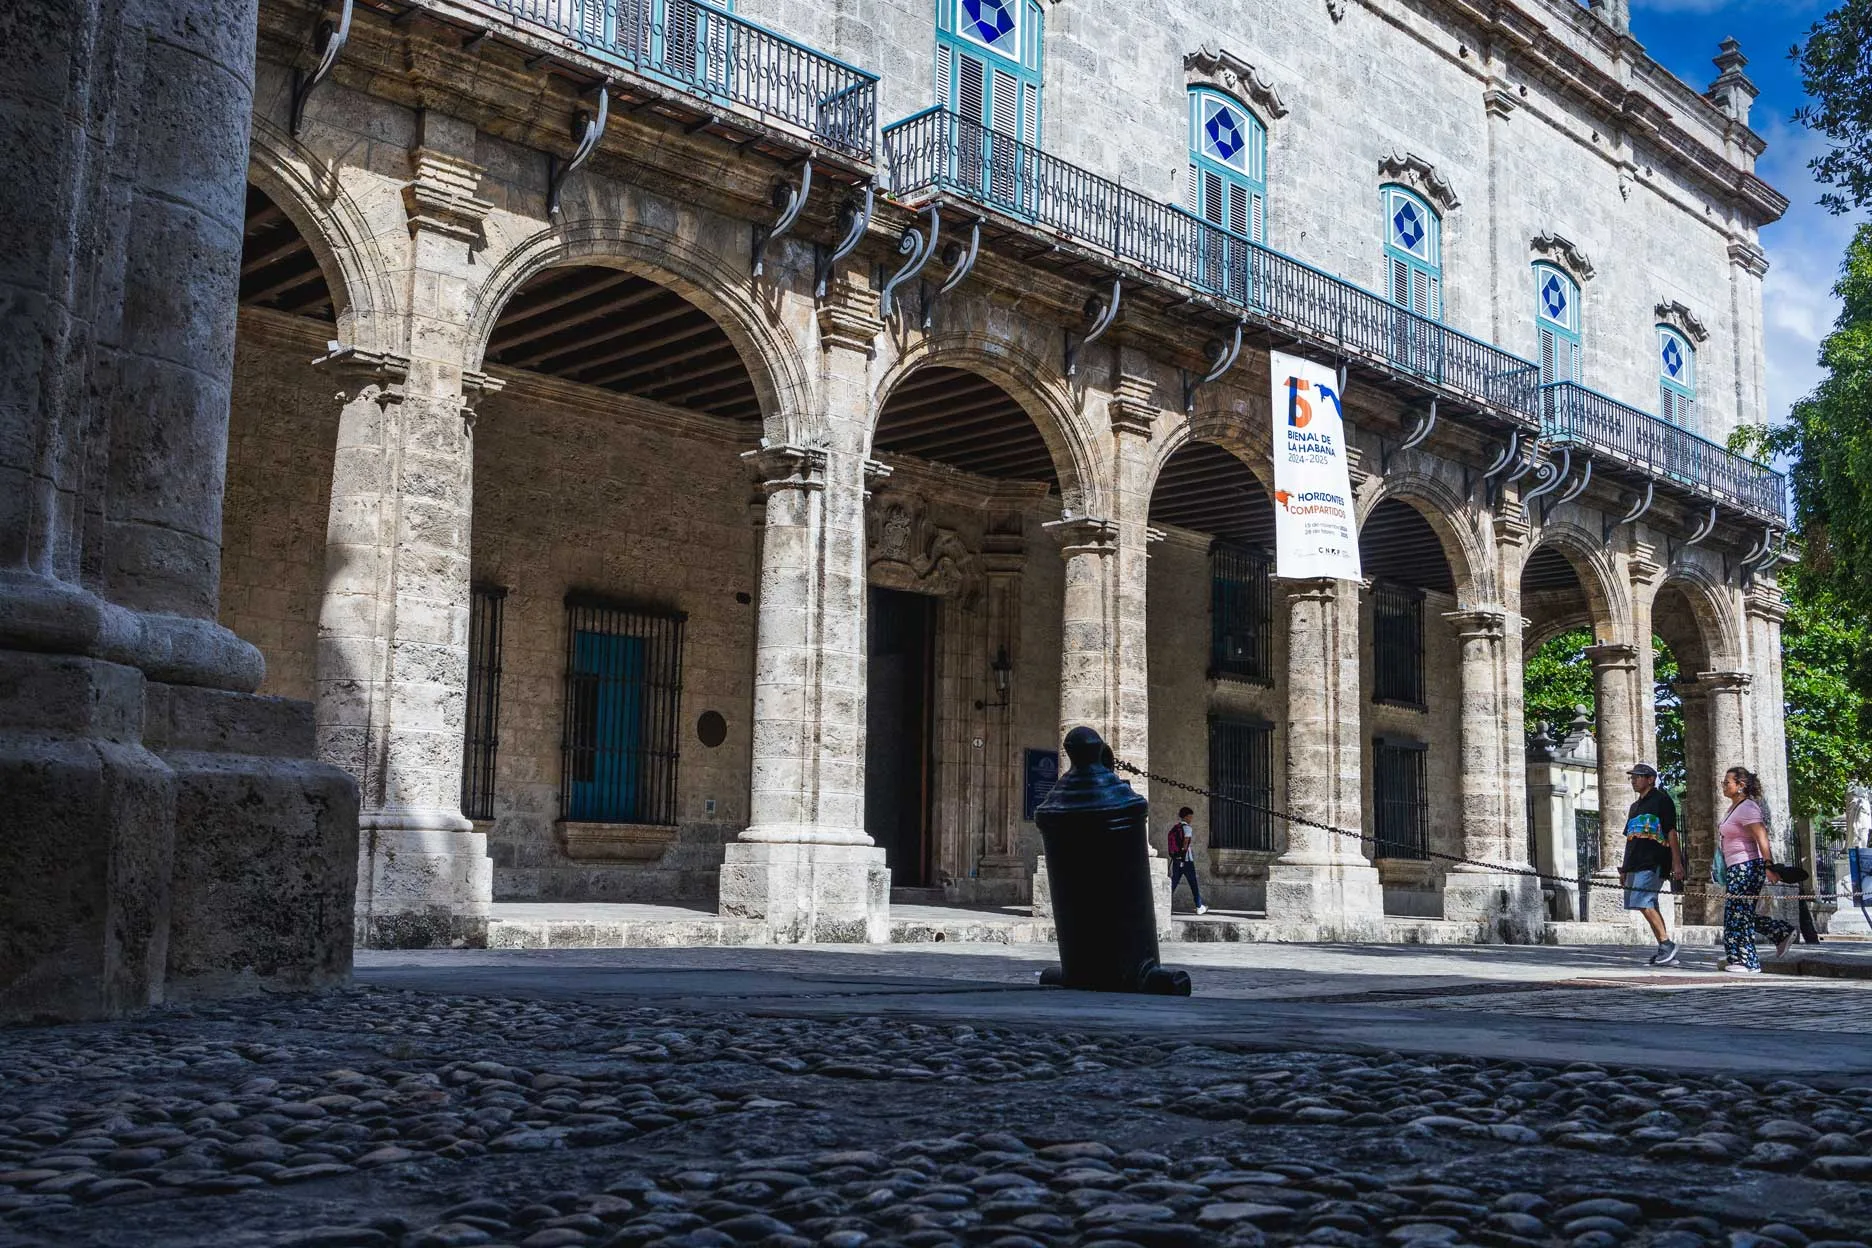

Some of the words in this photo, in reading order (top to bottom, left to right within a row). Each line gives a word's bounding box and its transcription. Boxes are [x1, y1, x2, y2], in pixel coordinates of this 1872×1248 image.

[1283, 376, 1312, 428] 15
[1288, 430, 1319, 442] BIENAL
[1321, 434, 1332, 445] DE
[1288, 442, 1298, 452] LA
[1298, 443, 1336, 457] HABANA
[1297, 492, 1345, 506] HORIZONTES
[1290, 506, 1346, 519] COMPARTIDOS
